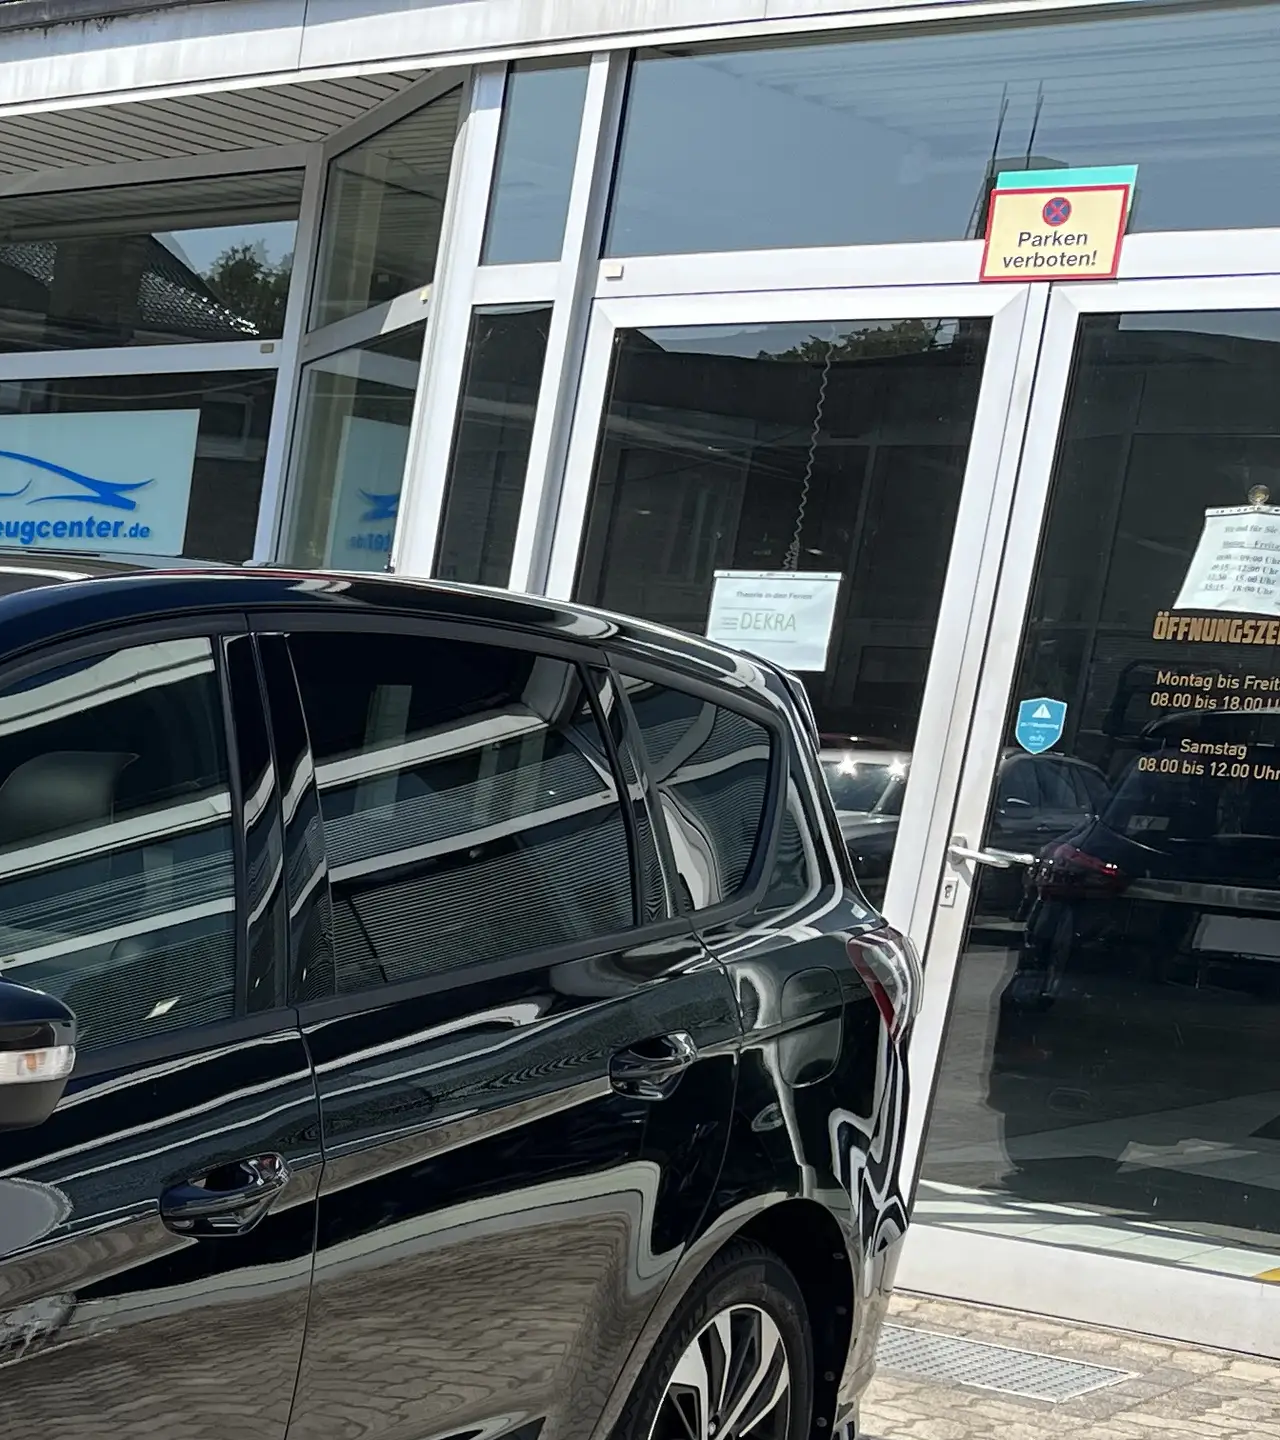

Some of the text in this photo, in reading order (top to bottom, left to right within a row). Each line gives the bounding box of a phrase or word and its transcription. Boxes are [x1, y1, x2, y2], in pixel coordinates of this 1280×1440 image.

[1018, 230, 1089, 248] Parken
[1003, 250, 1097, 268] verboten!
[741, 612, 797, 632] DEKRA
[1156, 671, 1280, 691] Montag bis Freit
[1150, 692, 1191, 708] 08.00
[1194, 694, 1217, 709] bis
[1223, 696, 1263, 711] 18.00
[1180, 738, 1247, 760] Samstag
[1138, 757, 1280, 780] 08.00 bis 12.00 Uhr
